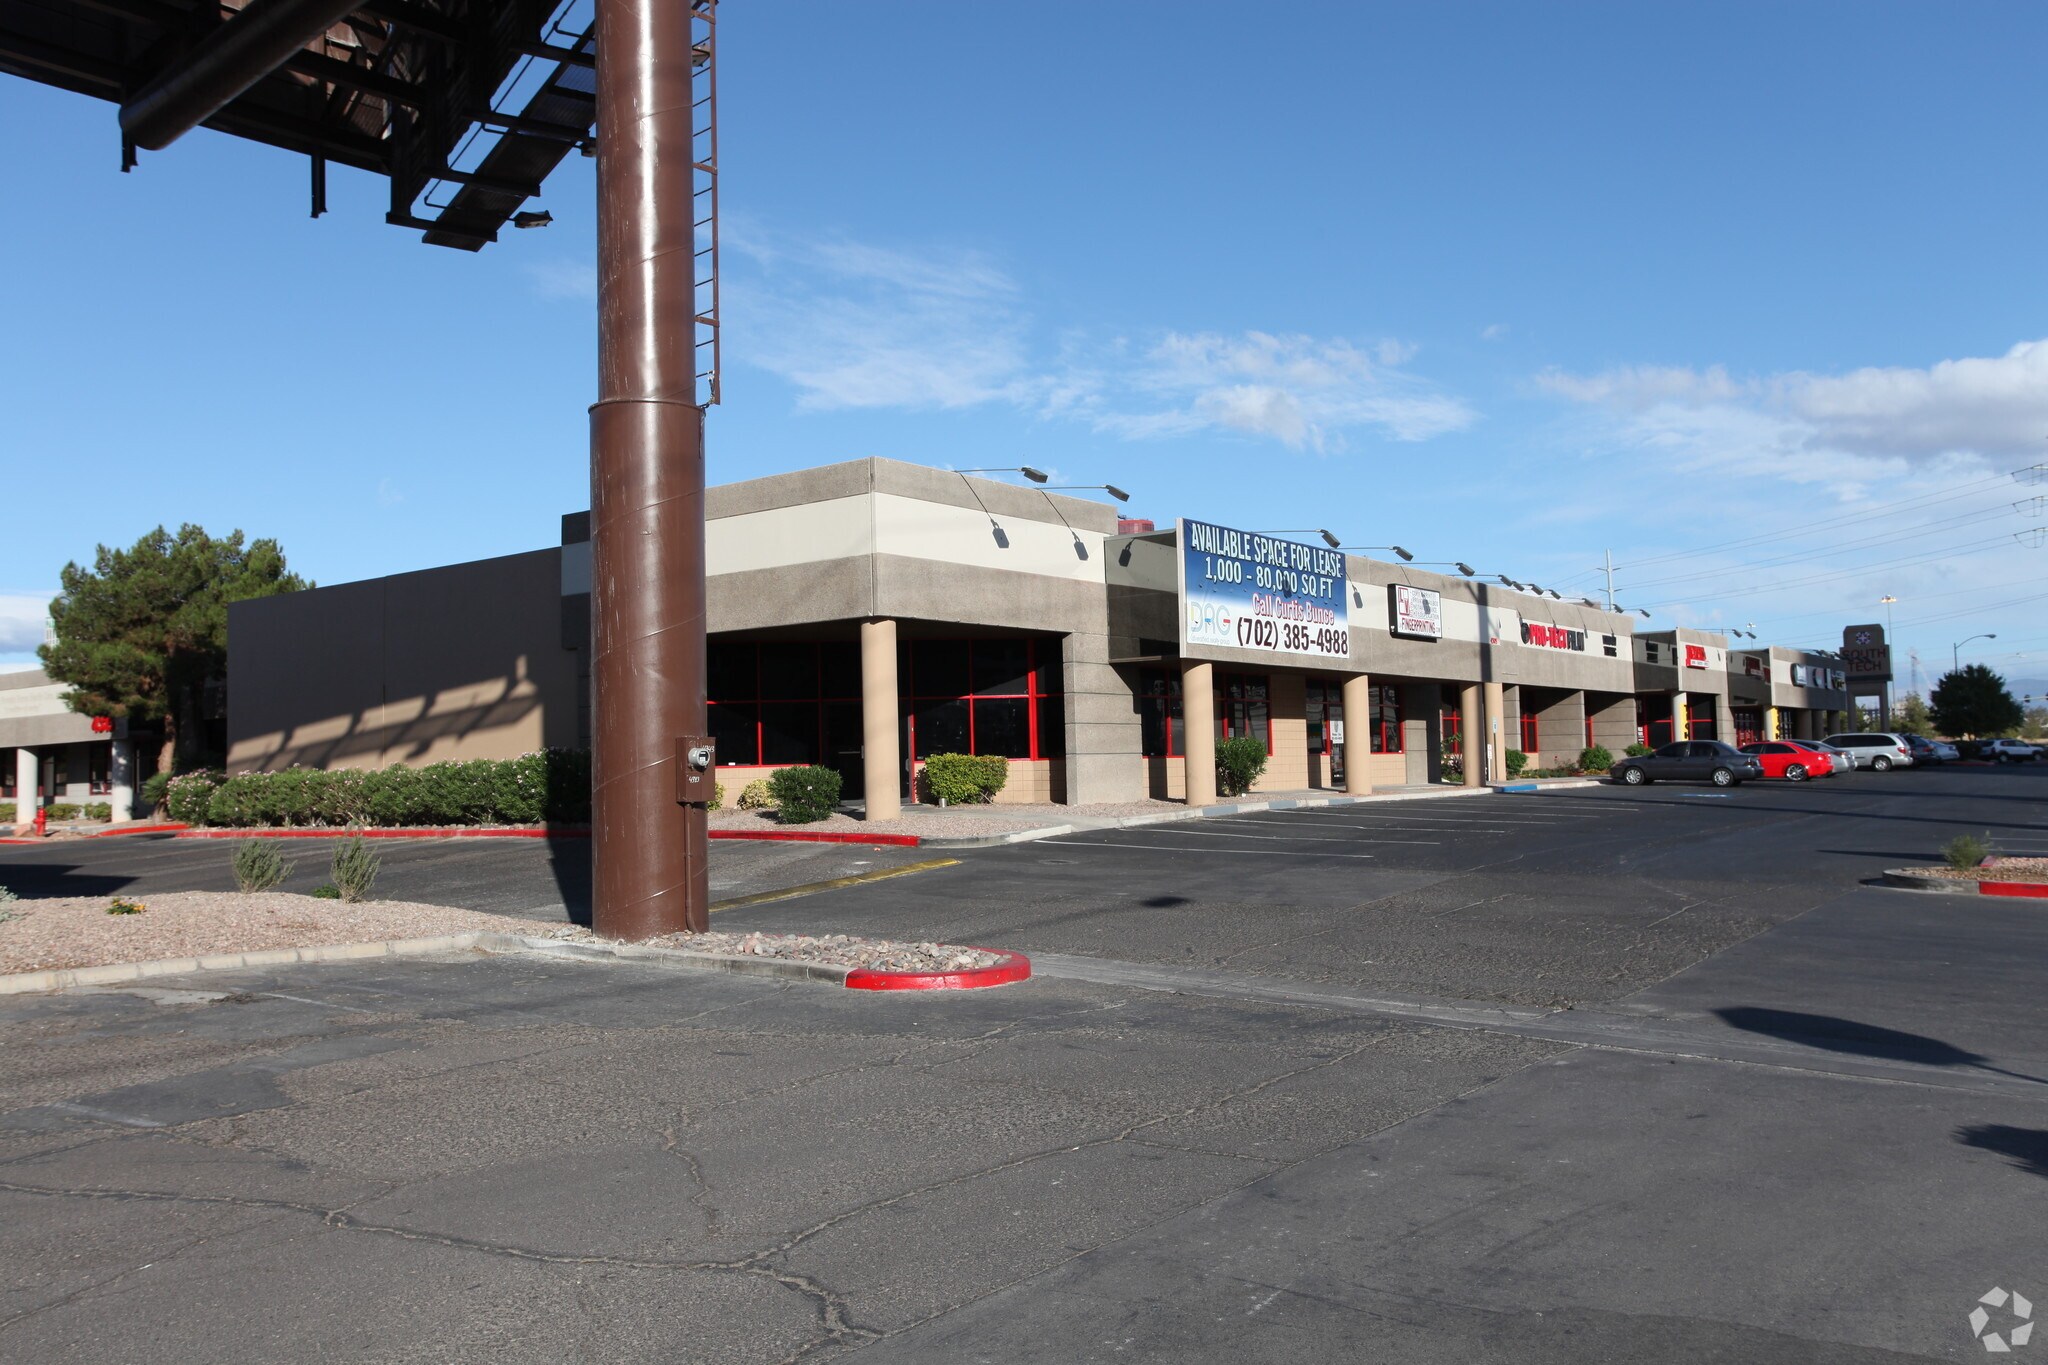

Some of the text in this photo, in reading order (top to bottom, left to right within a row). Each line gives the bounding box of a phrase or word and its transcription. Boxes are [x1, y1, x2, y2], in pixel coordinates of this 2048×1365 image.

[1191, 523, 1342, 578] AVAILABLE SPACE FOR LEASE
[1205, 556, 1242, 585] 1,000
[1256, 566, 1298, 593] 80,000
[1301, 574, 1317, 598] SQ
[1320, 578, 1333, 599] FT
[1252, 592, 1335, 626] Call Curtis Bunce
[1237, 616, 1348, 656] (702) 385-4988
[1842, 648, 1886, 660] SOUTH
[1848, 660, 1881, 672] TECH
